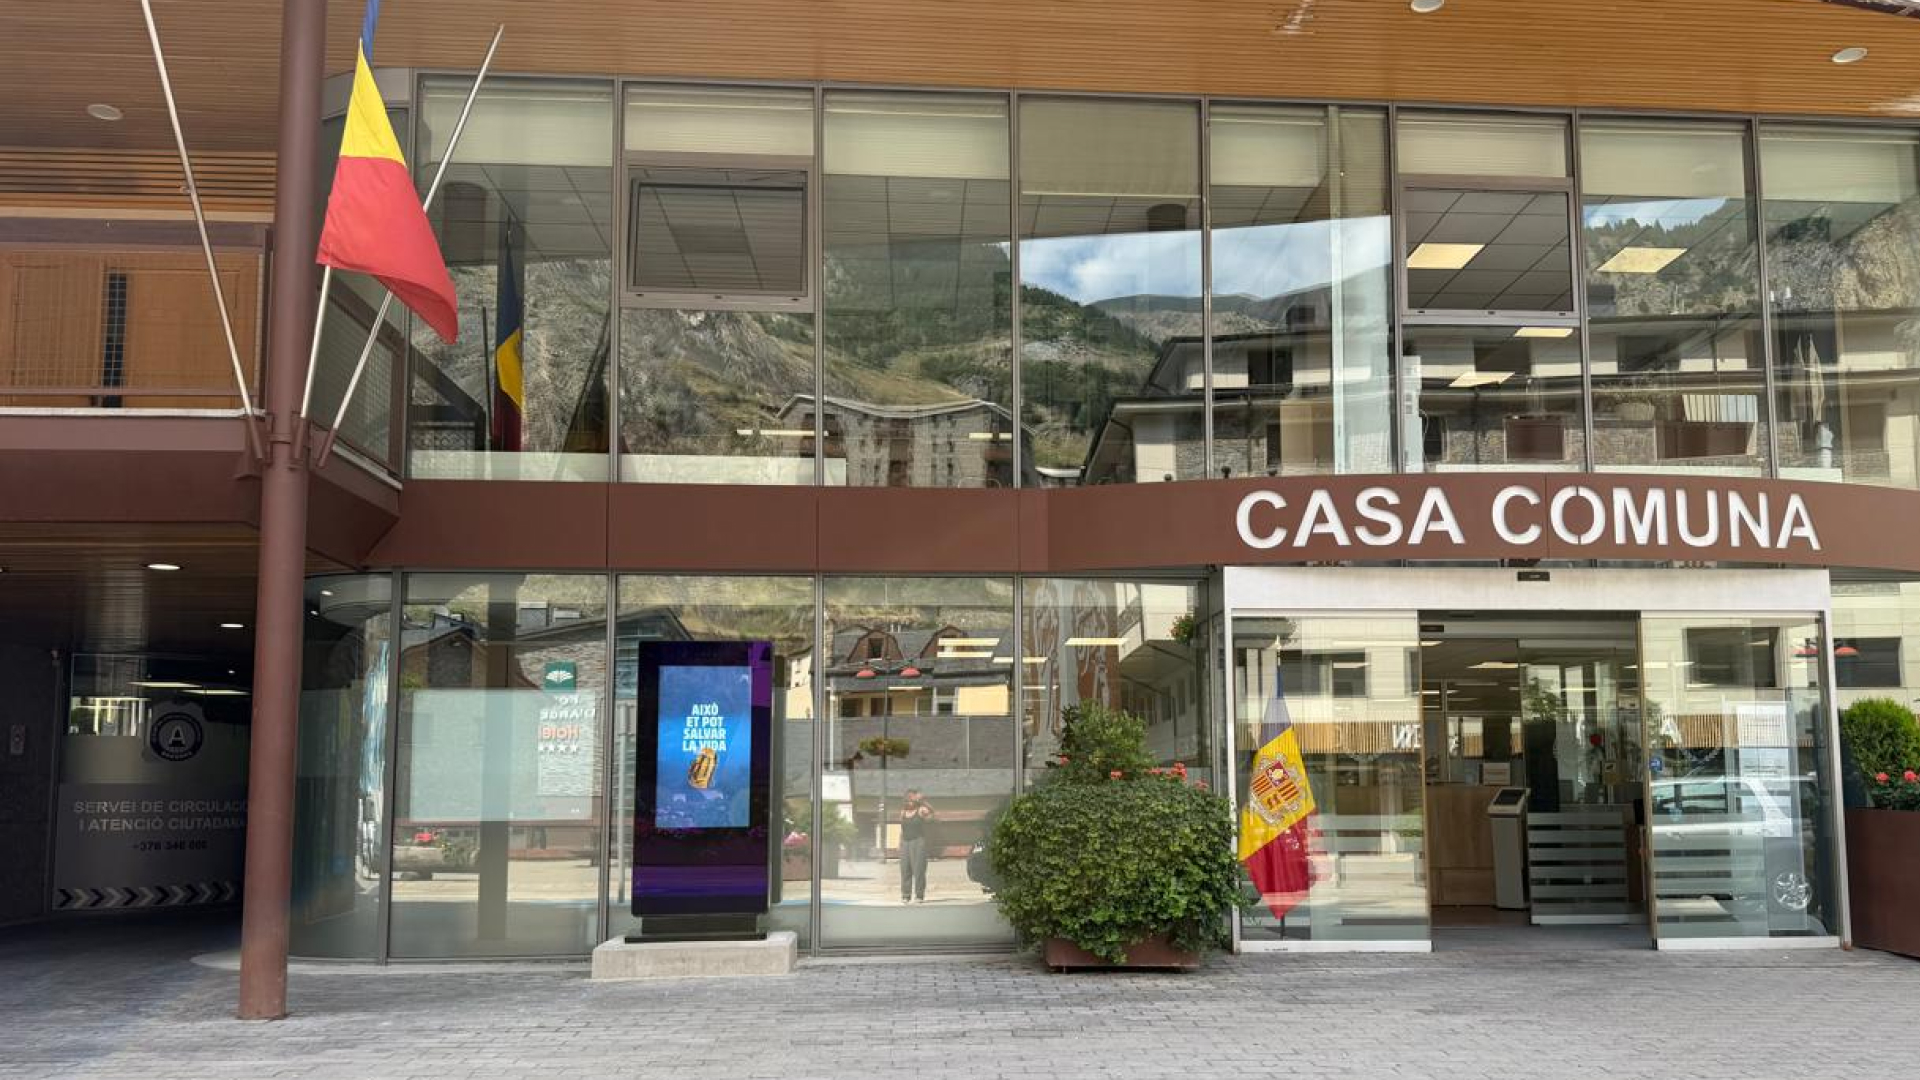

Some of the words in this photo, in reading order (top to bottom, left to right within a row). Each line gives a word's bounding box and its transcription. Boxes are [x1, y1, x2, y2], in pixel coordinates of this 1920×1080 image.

[1236, 486, 1465, 549] CASA
[1492, 485, 1822, 551] COMUNA
[692, 702, 719, 716] AIXÒ
[686, 717, 700, 728] ET
[702, 717, 724, 728] POT
[683, 728, 727, 740] SALVAR
[682, 741, 697, 752] LA
[700, 741, 727, 752] VIDA
[74, 801, 137, 813] SERVEI
[142, 801, 164, 813] DE
[88, 817, 164, 831] ATENCIÓ
